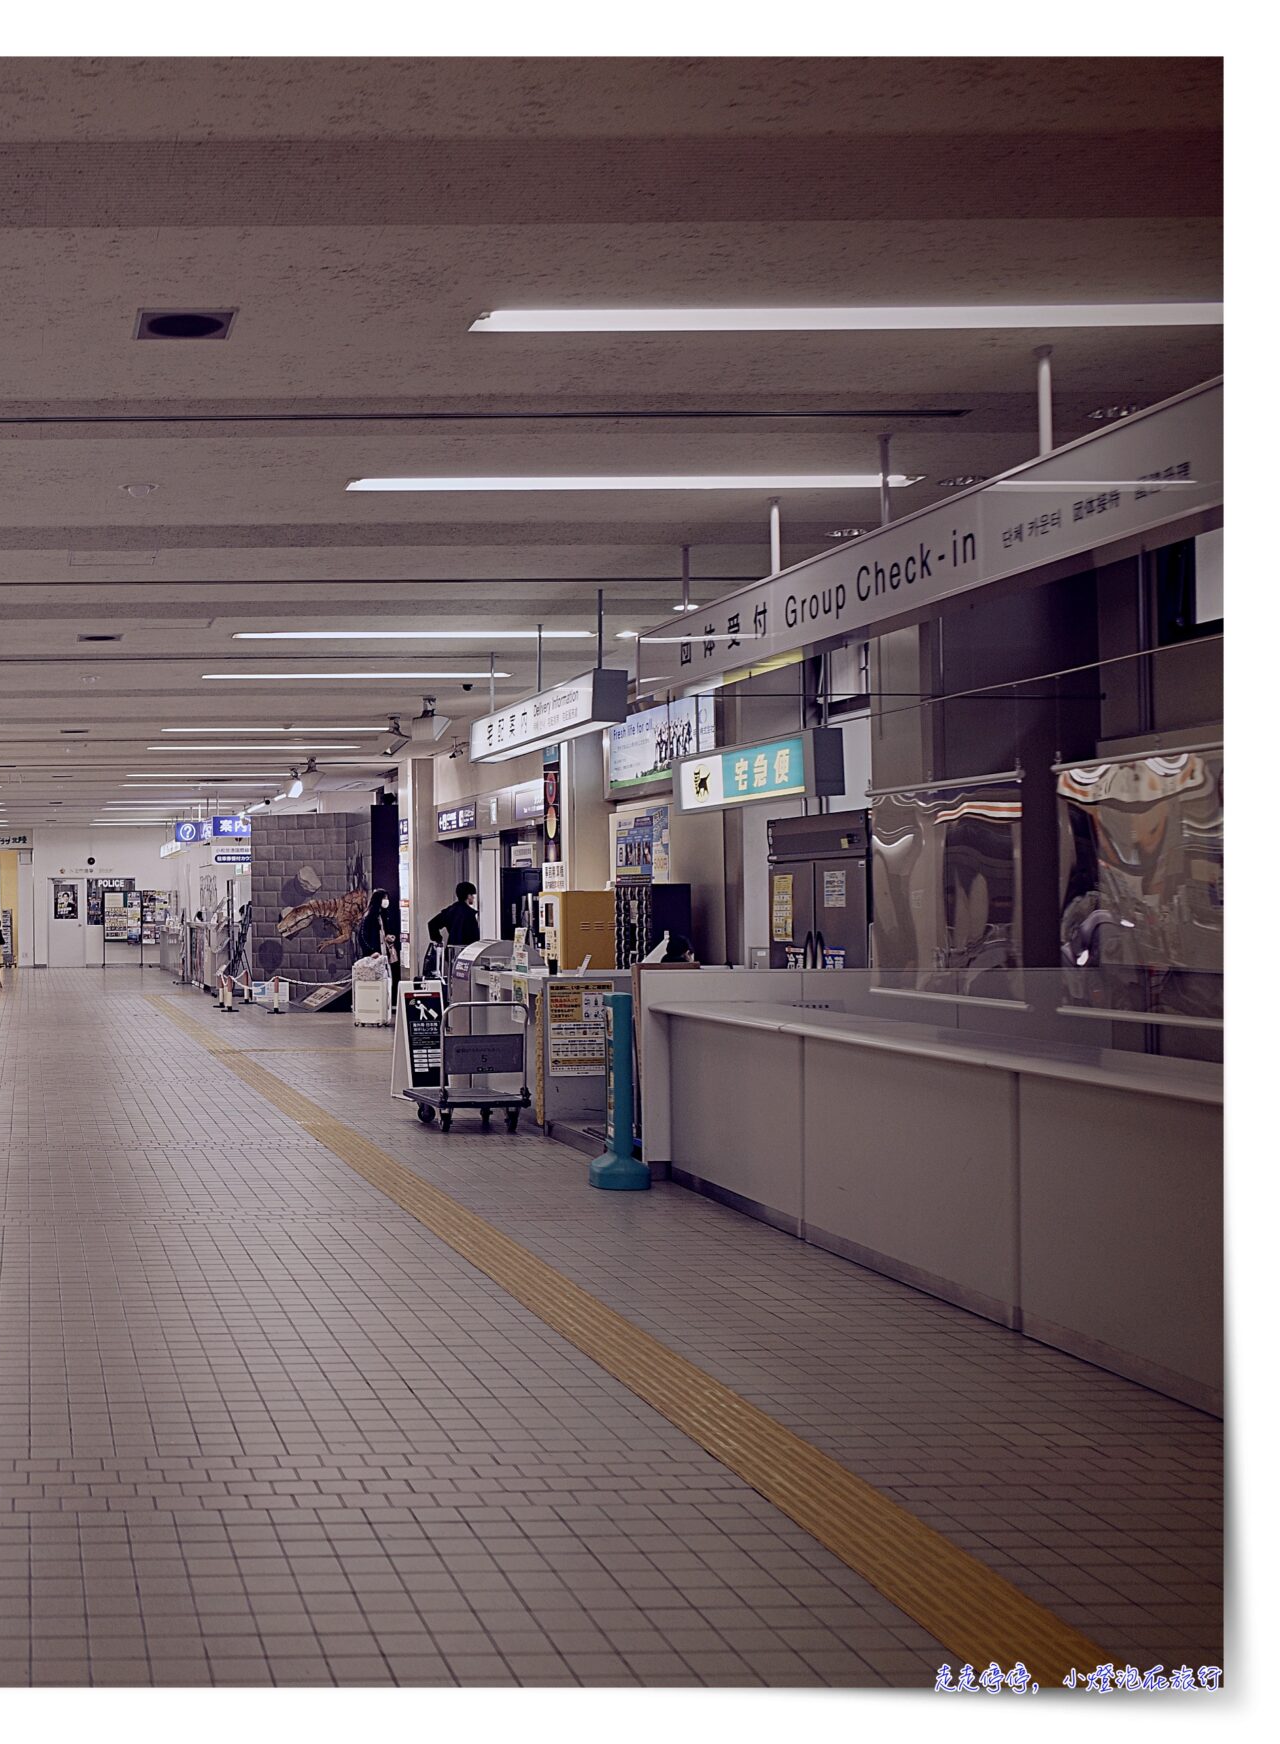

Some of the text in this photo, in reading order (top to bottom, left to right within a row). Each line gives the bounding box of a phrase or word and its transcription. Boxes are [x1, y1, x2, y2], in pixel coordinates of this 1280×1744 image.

[1028, 508, 1061, 537] 카운터
[785, 529, 976, 628] Group Check-in
[680, 602, 767, 666] 団体受付
[533, 690, 579, 718] Delivery Information
[613, 727, 627, 740] Fresh
[627, 722, 636, 737] life
[637, 721, 646, 734] for
[734, 748, 790, 791] 宅急便
[98, 879, 125, 887] POLICE
[481, 1054, 488, 1063] 5
